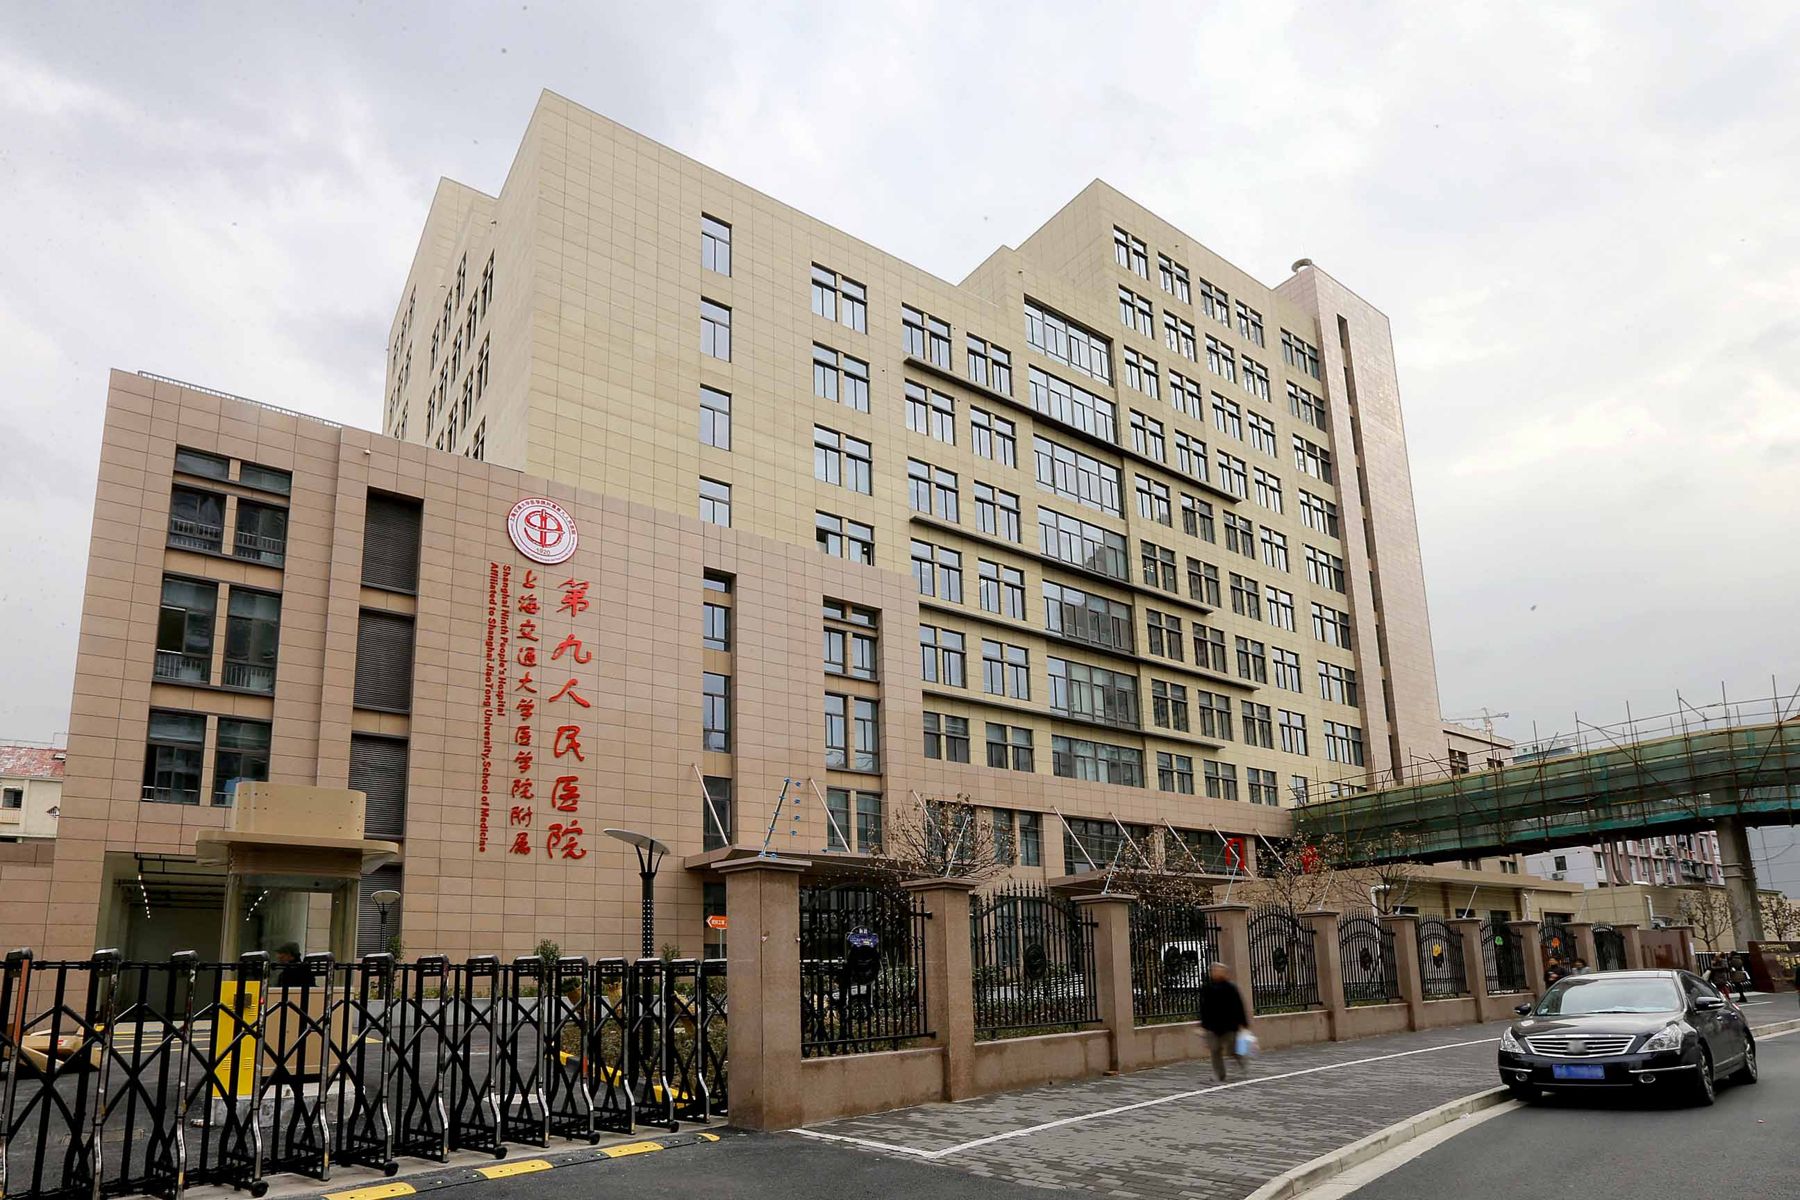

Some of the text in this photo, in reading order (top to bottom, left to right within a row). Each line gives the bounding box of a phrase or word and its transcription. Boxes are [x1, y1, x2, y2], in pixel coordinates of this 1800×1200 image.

[488, 562, 499, 606] Affiliated
[488, 606, 496, 617] to
[485, 617, 497, 662] Shanghai
[496, 564, 511, 717] Shanghai Ninth People's Hospital
[510, 569, 539, 854] 上海交通大学医学院附属
[547, 577, 592, 859] 第九人民医院
[481, 796, 490, 807] of
[479, 807, 490, 853] Medicine
